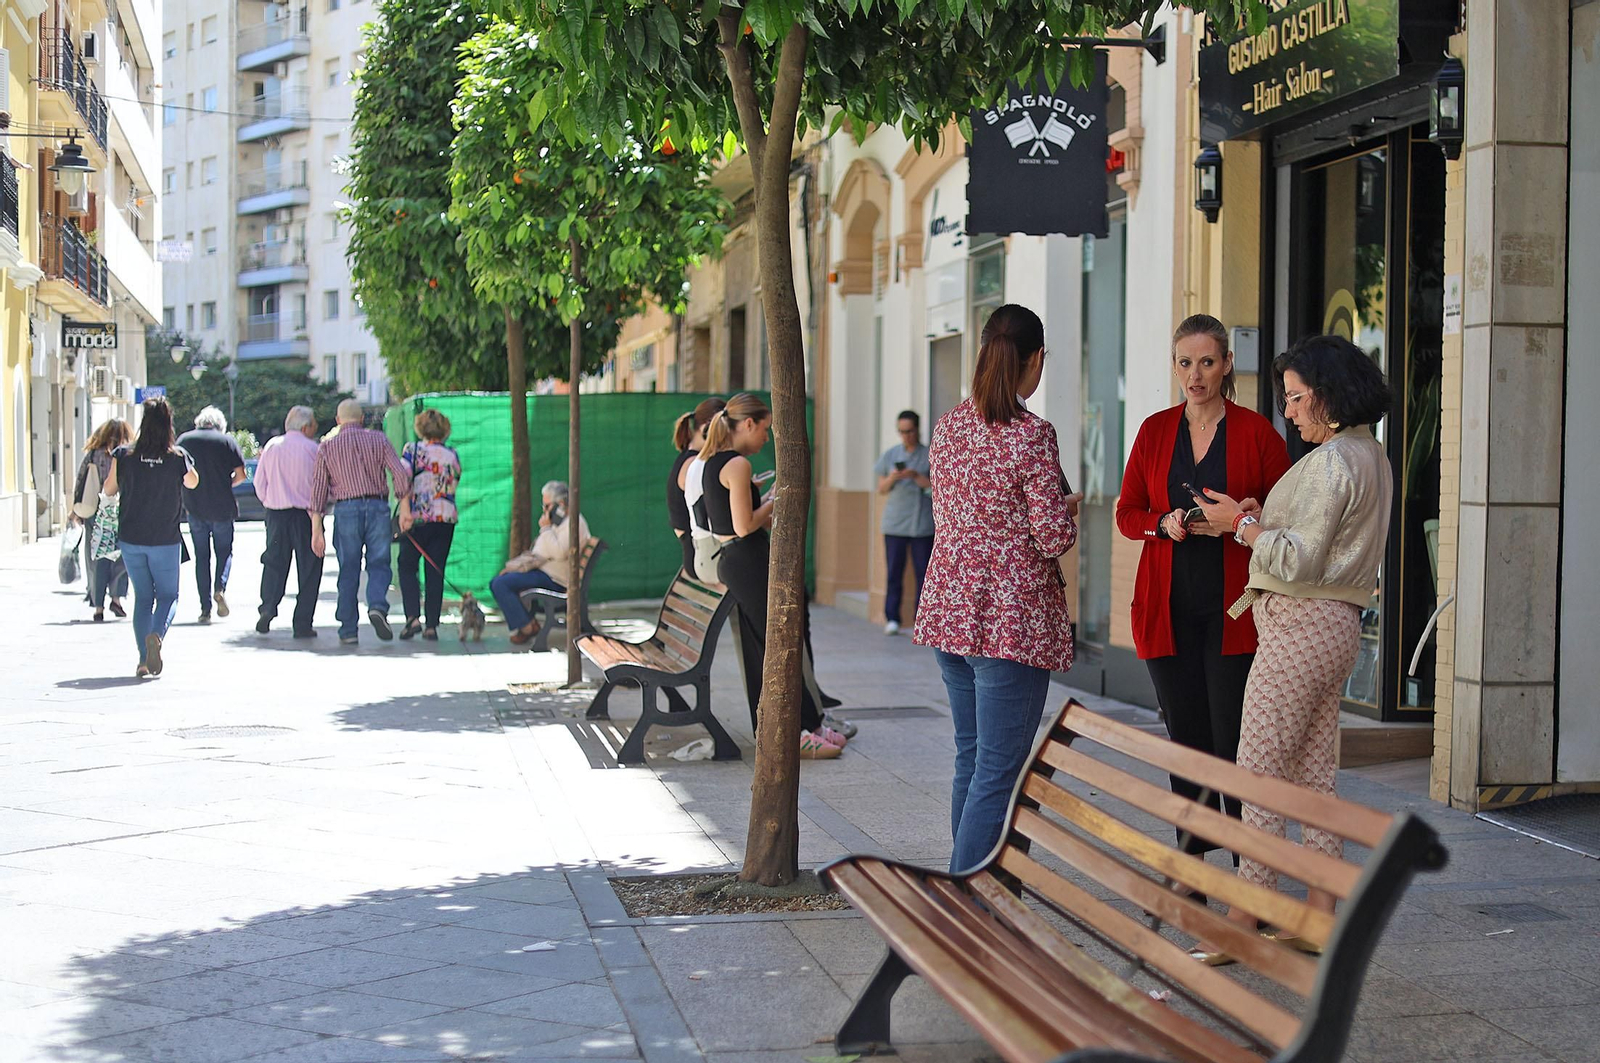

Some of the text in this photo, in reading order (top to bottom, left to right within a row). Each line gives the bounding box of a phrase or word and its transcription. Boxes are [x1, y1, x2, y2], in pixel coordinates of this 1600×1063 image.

[1228, 0, 1349, 75] GUSTAVO CASTILLA
[65, 331, 116, 348] moda
